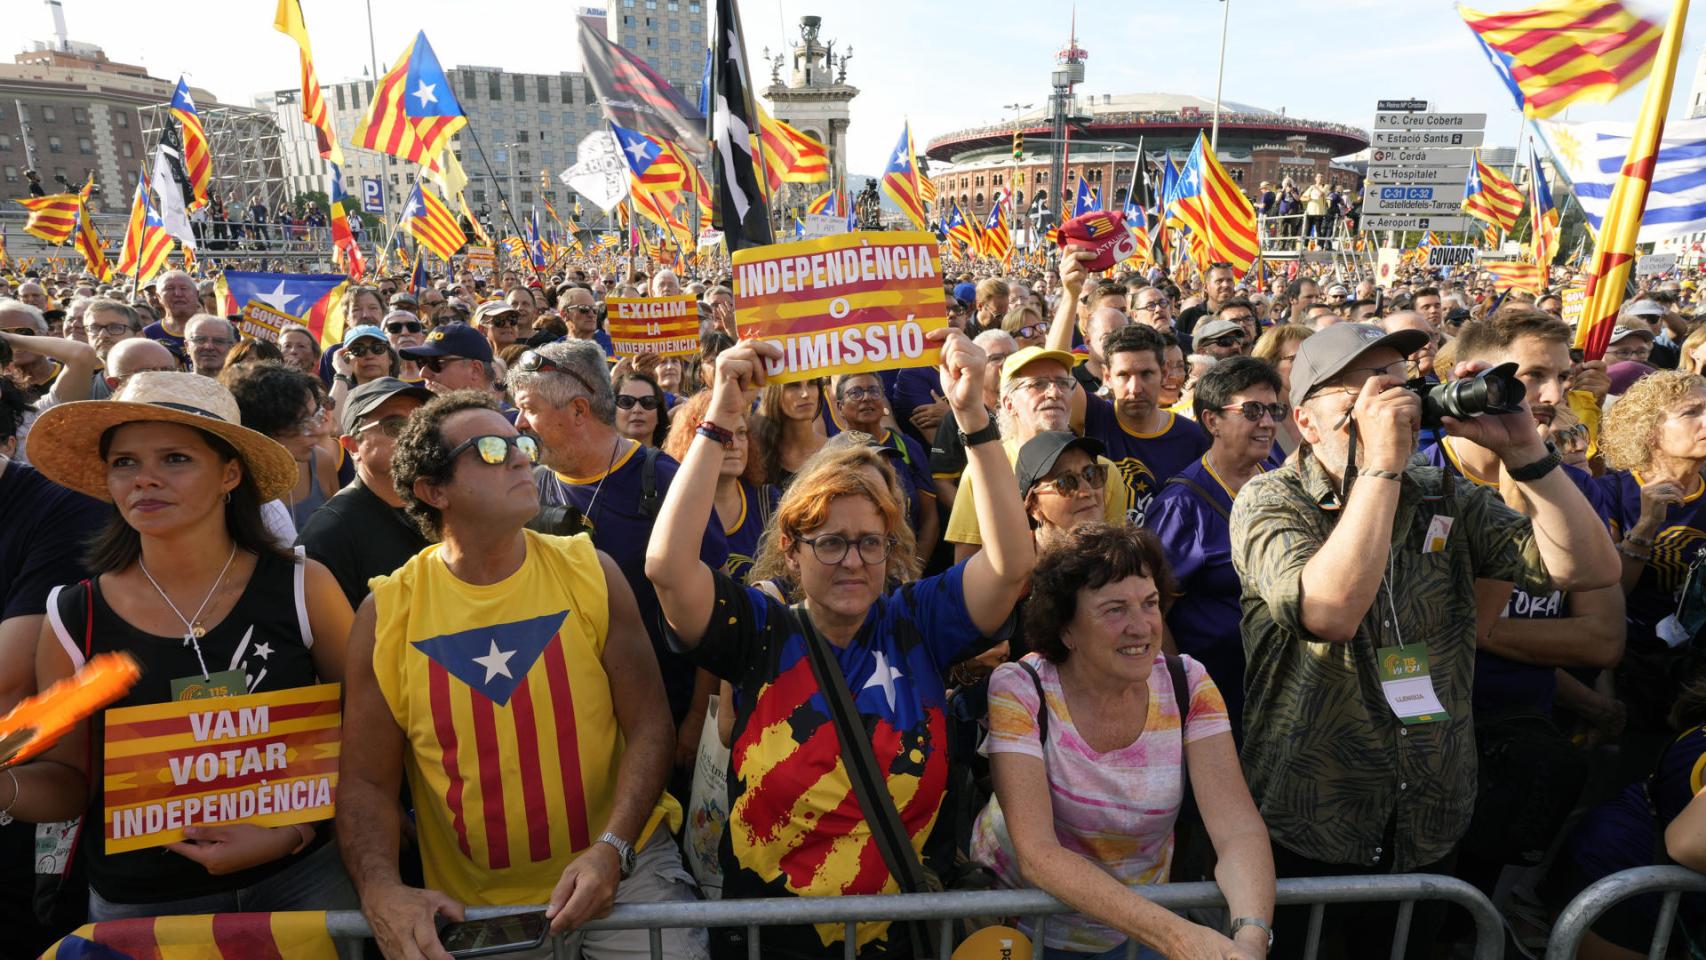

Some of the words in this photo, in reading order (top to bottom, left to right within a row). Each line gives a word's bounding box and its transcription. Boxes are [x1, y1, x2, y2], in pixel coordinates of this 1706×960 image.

[1390, 116, 1400, 126] C.
[1403, 116, 1424, 126] Creu
[1427, 115, 1463, 126] Coberta
[1387, 134, 1421, 143] Estació
[1424, 134, 1449, 143] Sants
[1385, 152, 1396, 161] Pl.
[1400, 151, 1426, 161] Cerdà
[1383, 169, 1437, 180] L'Hospitalet
[364, 180, 379, 204] P
[1384, 189, 1403, 198] C-31
[1410, 189, 1430, 198] C-32
[1379, 200, 1462, 210] Castelldefels-Tarrago
[1377, 219, 1416, 229] Aeroport
[1430, 248, 1474, 265] COVARDS
[739, 240, 935, 298] INDEPENDÈNCIA
[618, 300, 686, 318] EXIGIM
[829, 297, 850, 319] O
[251, 307, 298, 328] GOVER
[243, 321, 278, 343] DIMIS
[647, 322, 661, 336] LA
[615, 338, 697, 354] INDEPENDÈNCIA
[765, 314, 924, 376] DIMISSIÓ
[190, 705, 269, 742] VAM
[169, 742, 288, 786] VOTAR
[112, 778, 331, 840] INDEPENDÈNCIA
